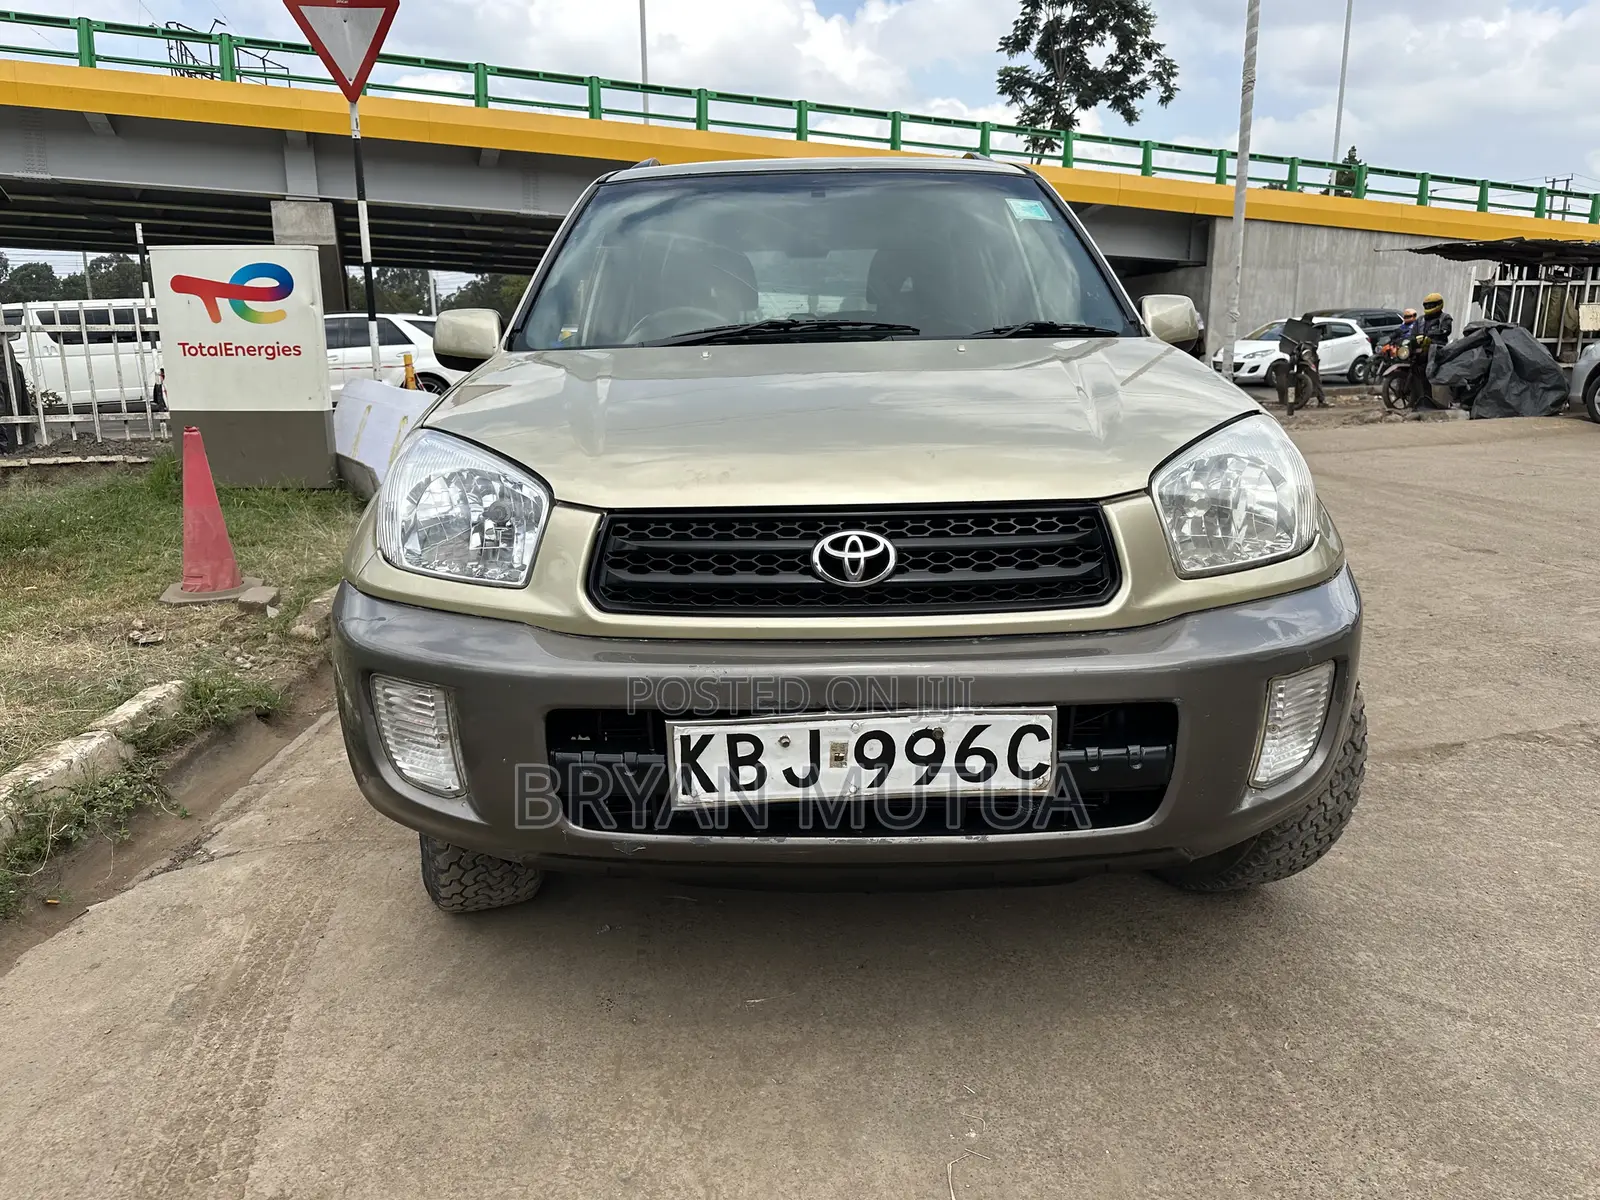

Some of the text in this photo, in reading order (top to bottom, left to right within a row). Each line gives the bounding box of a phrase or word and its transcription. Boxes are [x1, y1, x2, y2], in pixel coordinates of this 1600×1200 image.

[177, 342, 302, 360] TotalEnergies
[679, 723, 1051, 796] KBJ 996C
